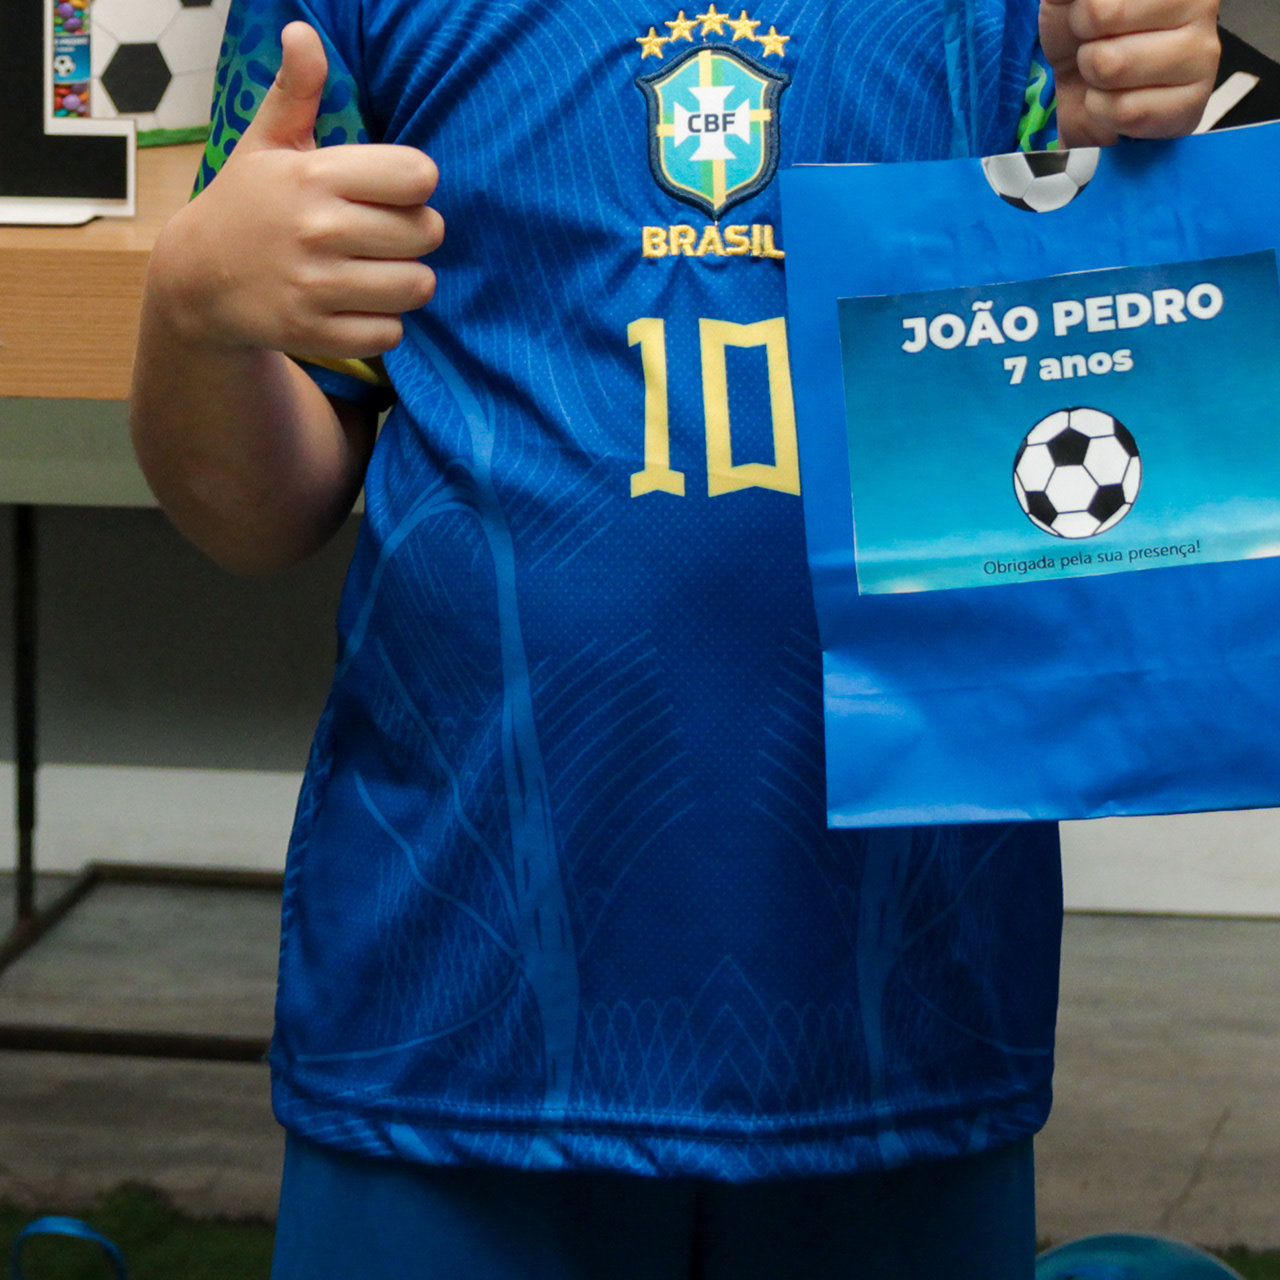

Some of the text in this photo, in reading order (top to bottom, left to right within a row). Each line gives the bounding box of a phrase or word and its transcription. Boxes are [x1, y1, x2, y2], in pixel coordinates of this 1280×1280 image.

[687, 112, 737, 134] CBF
[641, 223, 786, 260] BRASIL
[901, 282, 1224, 354] JOÃO PEDRO
[1003, 348, 1134, 385] 7 anos
[626, 315, 802, 499] 10
[983, 540, 1202, 575] Obrigada pela sua presença!
